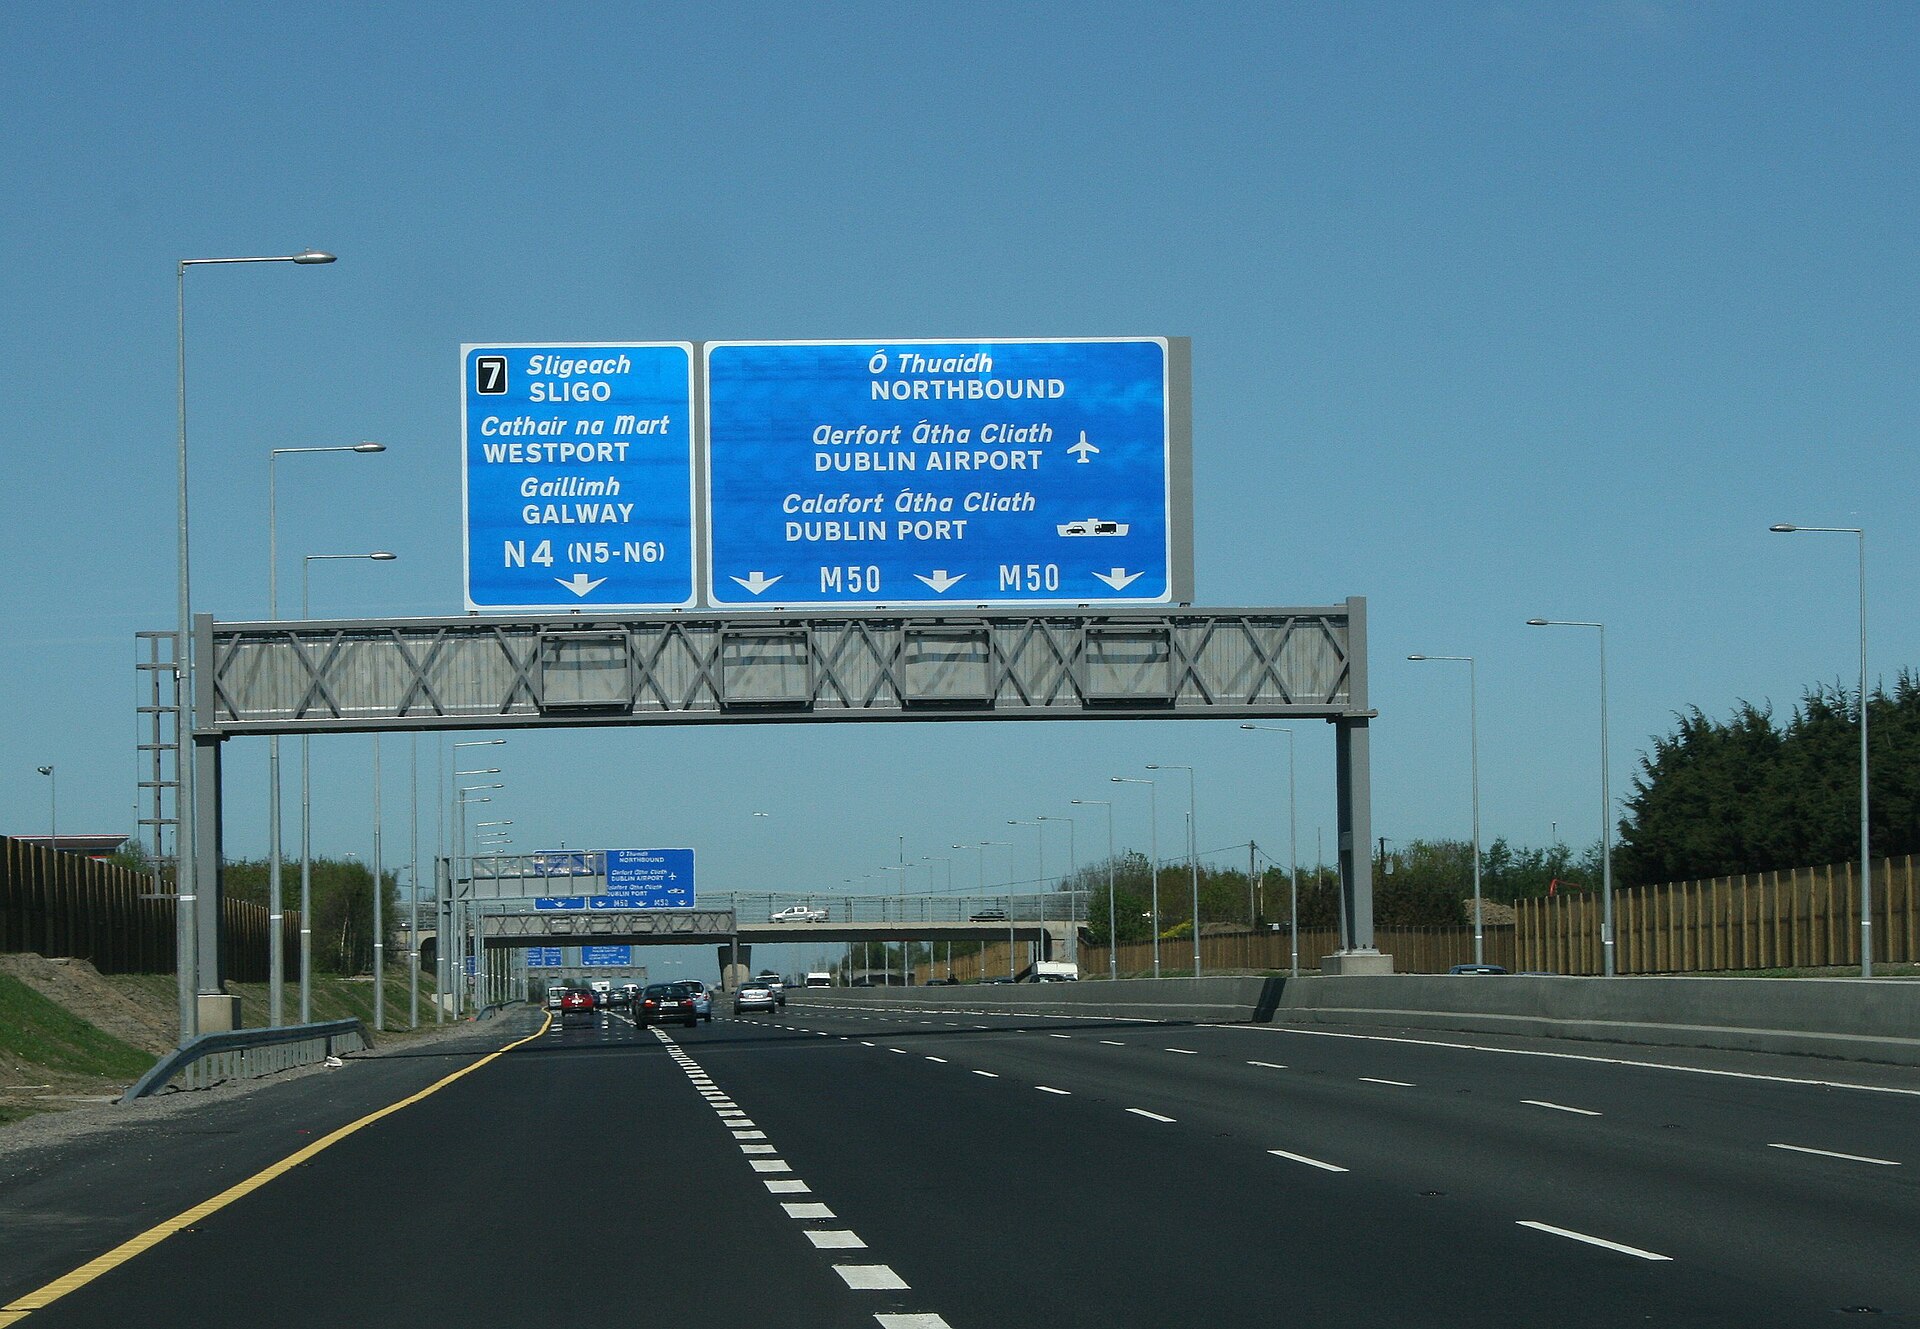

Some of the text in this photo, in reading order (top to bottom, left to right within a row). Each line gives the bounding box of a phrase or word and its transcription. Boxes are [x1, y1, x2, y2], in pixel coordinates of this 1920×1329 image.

[526, 354, 631, 378] Sligeach
[868, 349, 993, 374] Ó Thuaidh
[482, 362, 501, 389] 7
[529, 381, 611, 403] SLIGO
[871, 378, 1065, 401] NORTHBOUND
[481, 415, 670, 437] Cathair na Mart
[812, 419, 1053, 445] Aerfort Átha Cliath
[482, 442, 630, 463] WESTPORT
[815, 450, 1043, 472] DUBLIN AIRPORT
[520, 476, 620, 498] Gaillimh
[782, 487, 1036, 514] Calafort Átha Cliath
[522, 503, 634, 524] GALWAY
[785, 520, 967, 542] DUBLIN PORT
[504, 539, 665, 568] N4 (N5-N6)
[820, 563, 1059, 593] M50 M50
